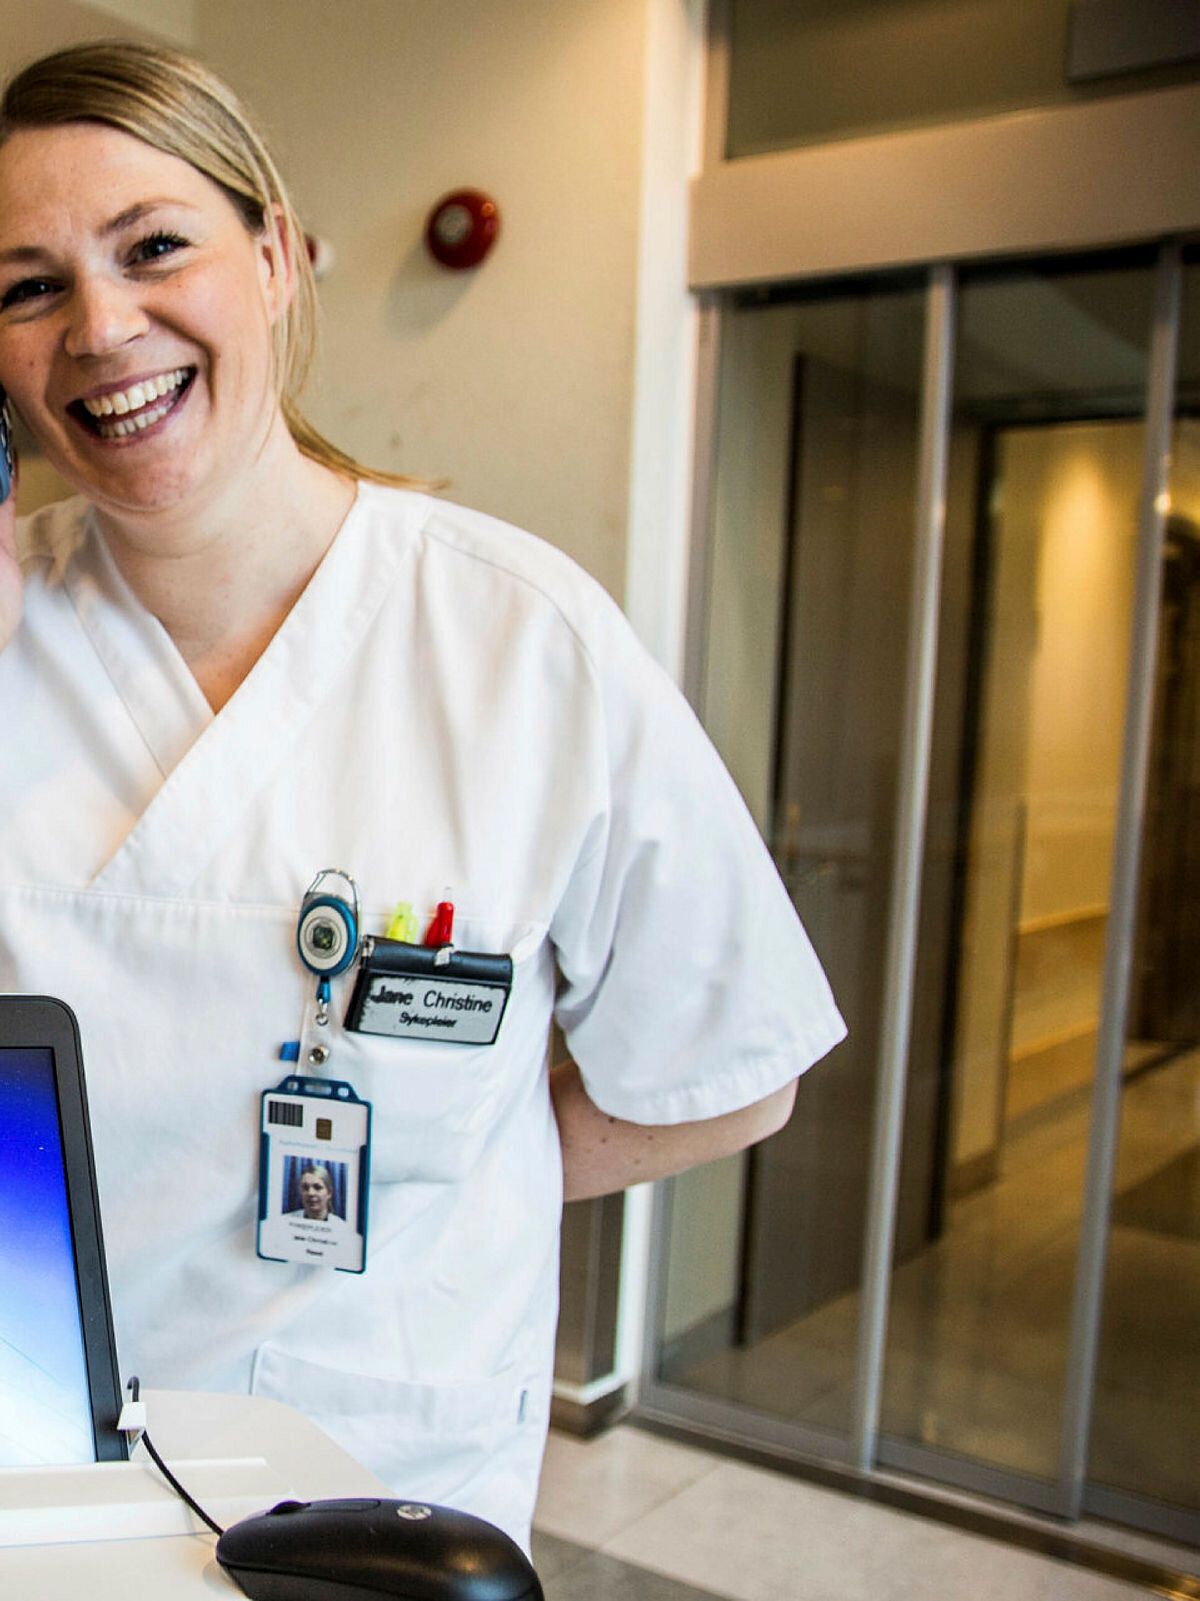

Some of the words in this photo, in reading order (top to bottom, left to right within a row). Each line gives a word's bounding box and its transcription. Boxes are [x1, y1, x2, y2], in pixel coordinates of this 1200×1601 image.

[370, 985, 414, 1005] Jane
[423, 990, 493, 1013] Christine
[399, 1011, 458, 1028] Sykepleier
